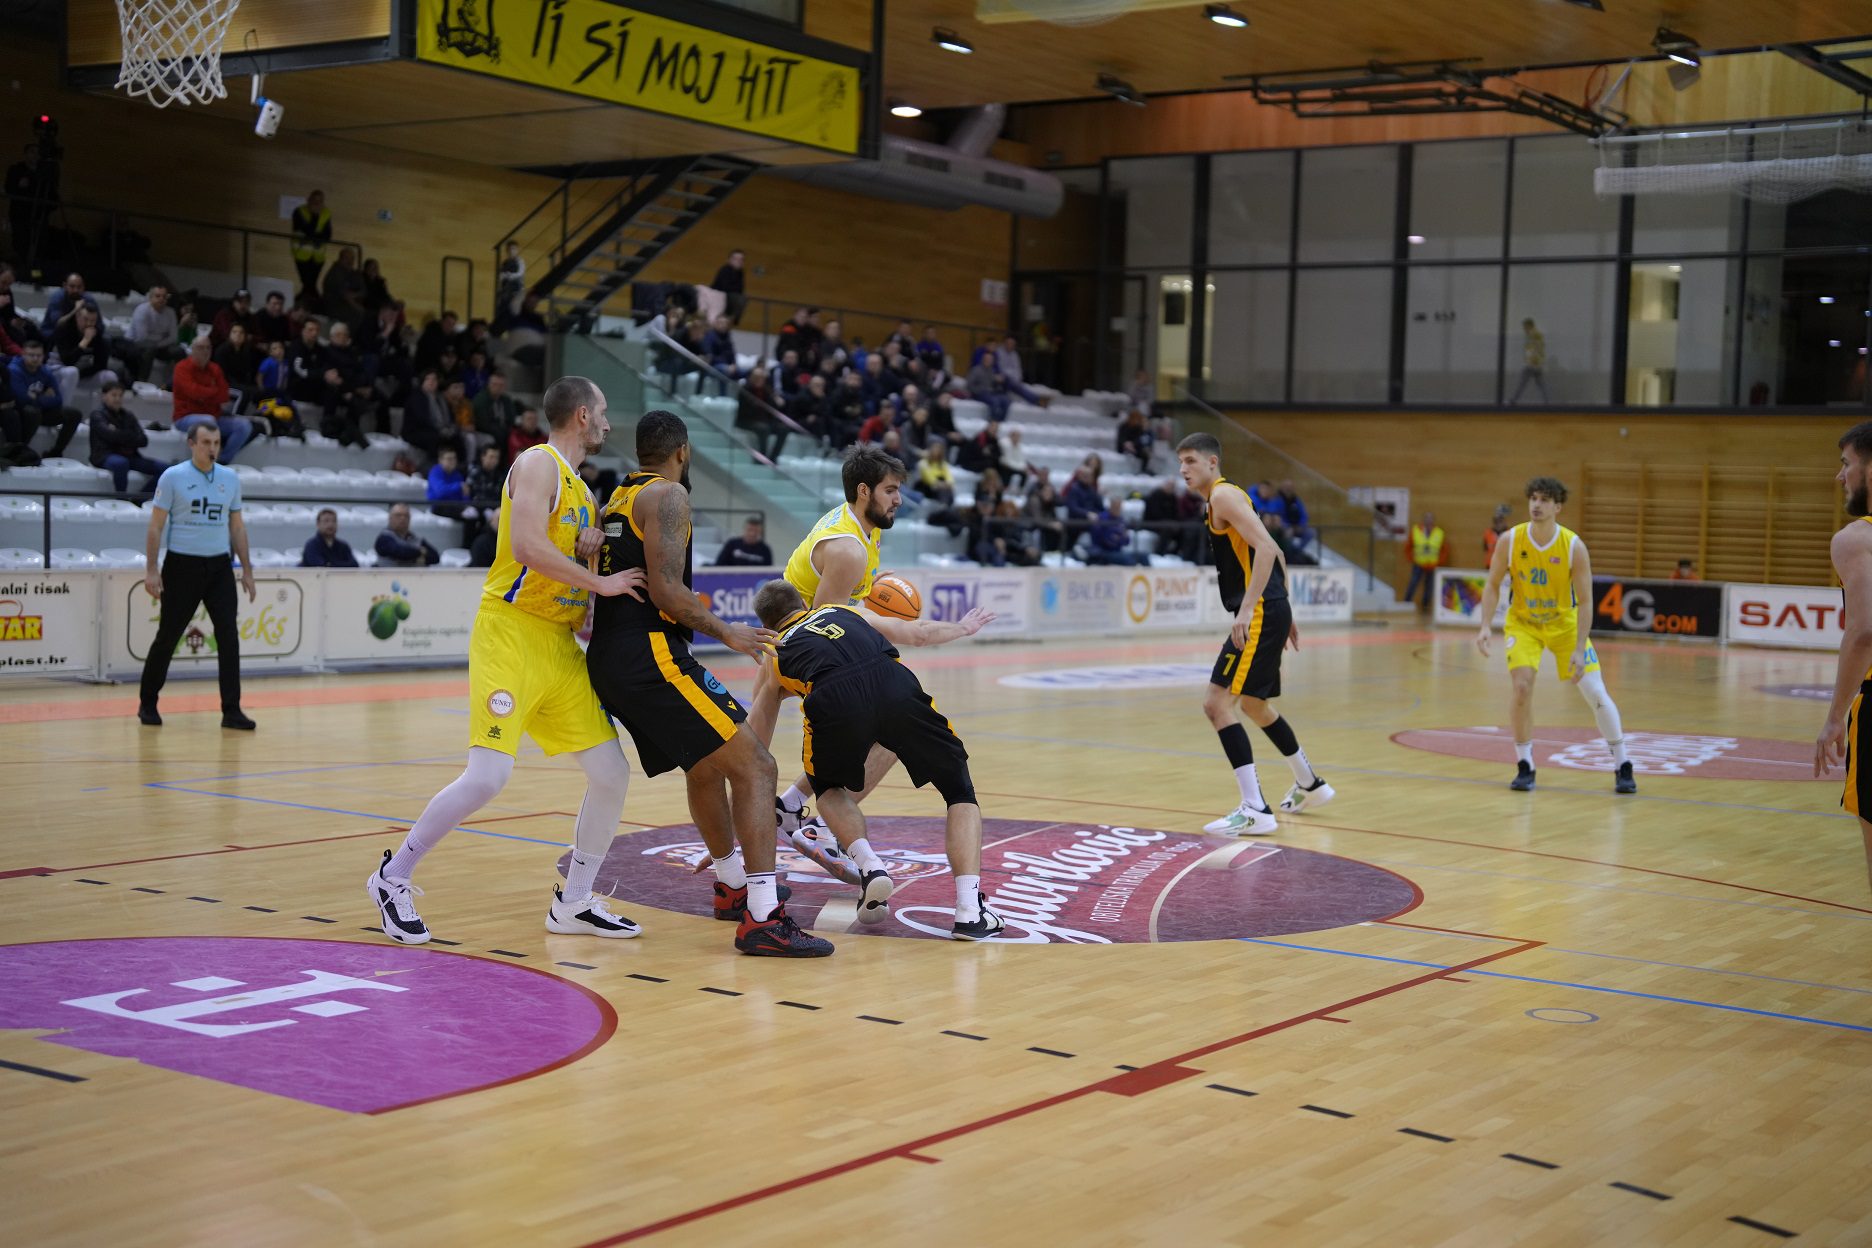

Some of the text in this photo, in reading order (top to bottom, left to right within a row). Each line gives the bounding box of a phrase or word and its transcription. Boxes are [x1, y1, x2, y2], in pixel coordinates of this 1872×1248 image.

[636, 36, 726, 104] MOJ
[1530, 567, 1548, 585] 20
[0, 581, 70, 595] alni tisak
